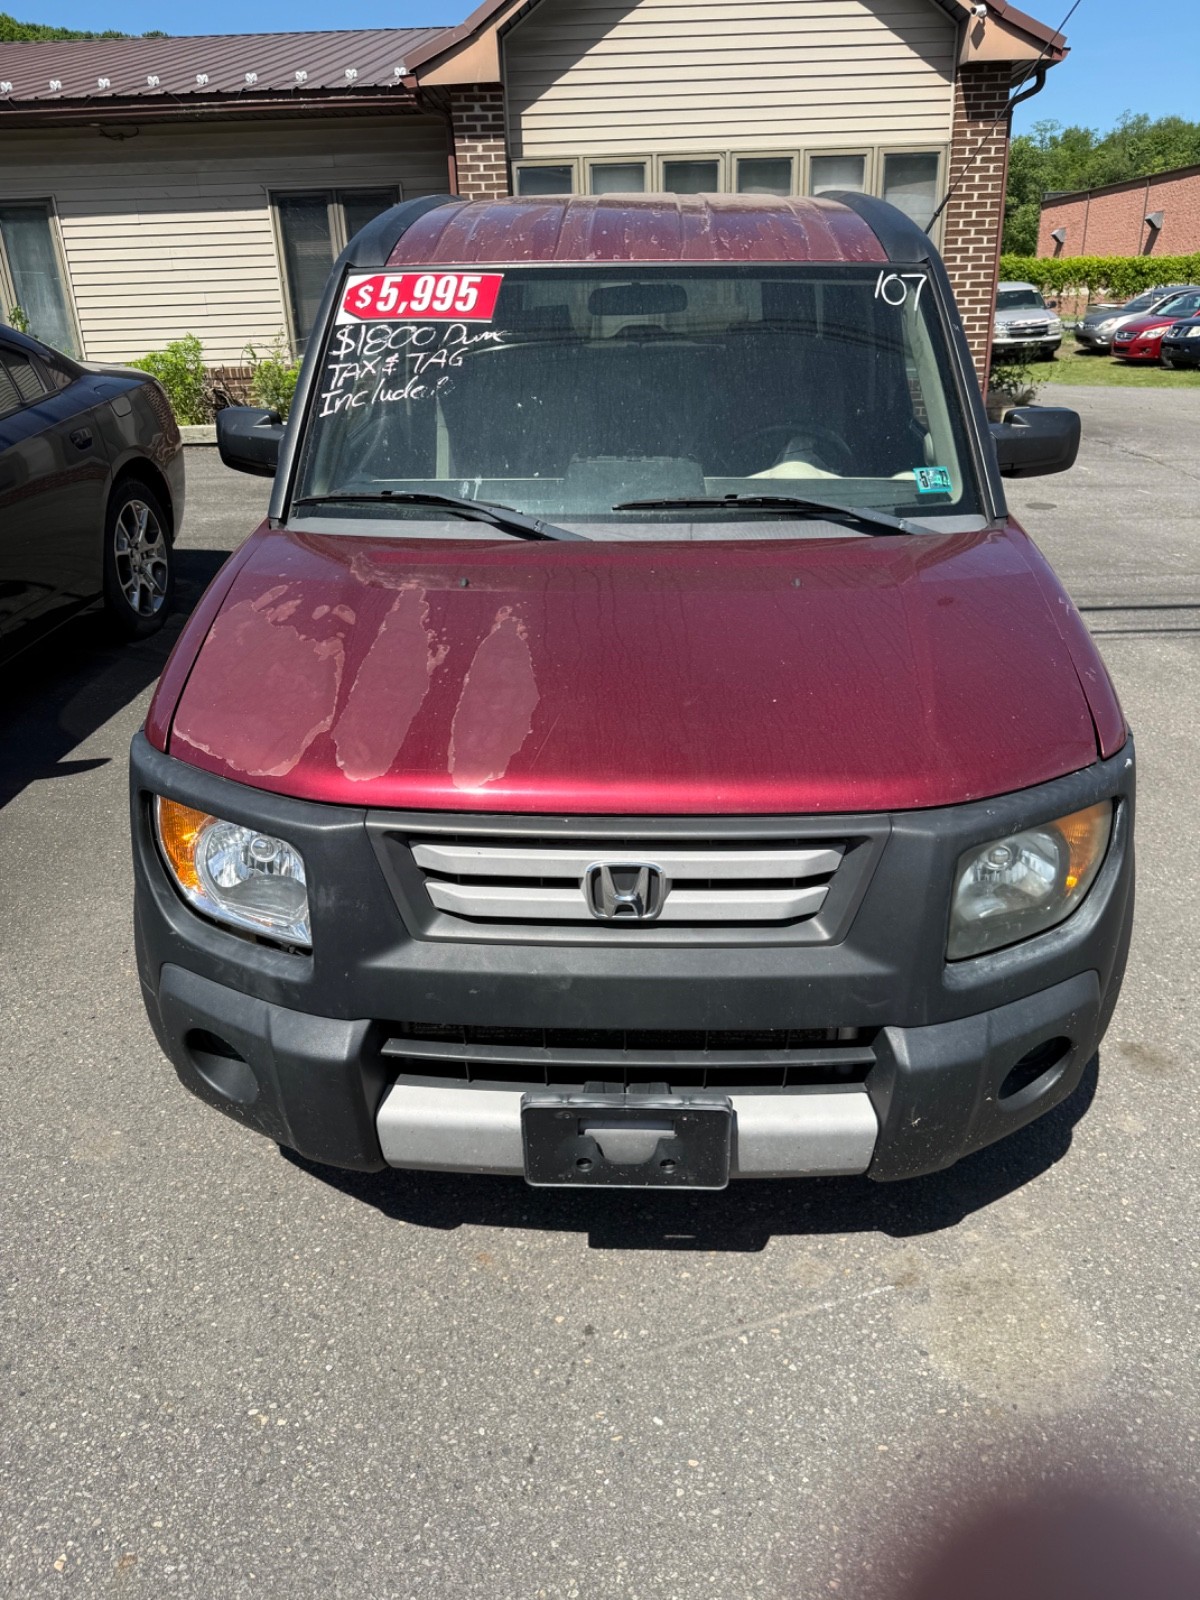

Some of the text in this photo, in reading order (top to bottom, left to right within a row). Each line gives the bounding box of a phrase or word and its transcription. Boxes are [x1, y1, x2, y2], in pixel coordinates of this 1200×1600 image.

[354, 275, 483, 315] $5,995
[874, 270, 928, 312] 107
[329, 324, 437, 361] $1800
[327, 355, 382, 391] TAX
[406, 347, 470, 374] TAG
[919, 470, 929, 488] 5
